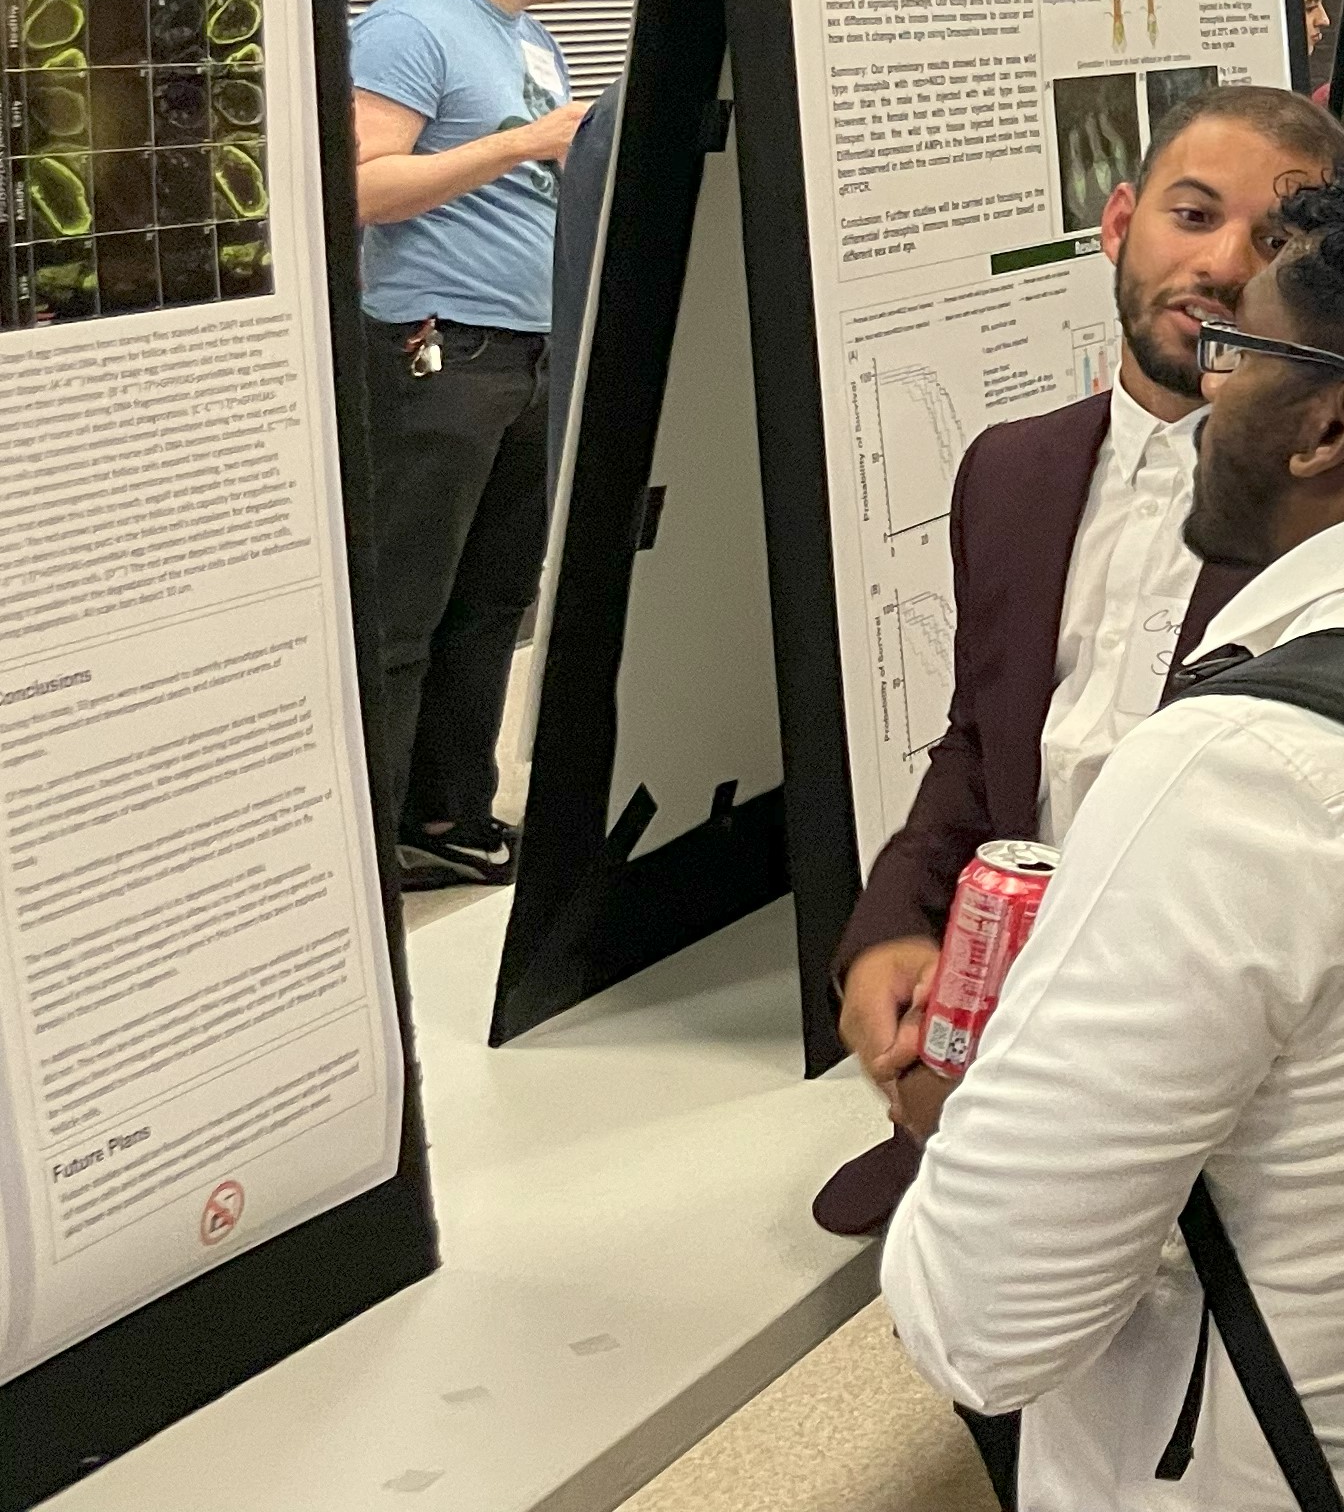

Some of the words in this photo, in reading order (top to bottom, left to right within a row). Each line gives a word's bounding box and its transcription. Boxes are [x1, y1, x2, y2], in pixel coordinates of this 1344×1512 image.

[0, 669, 92, 707] onclusions
[52, 1147, 105, 1182] Future
[109, 1124, 152, 1157] Plans
